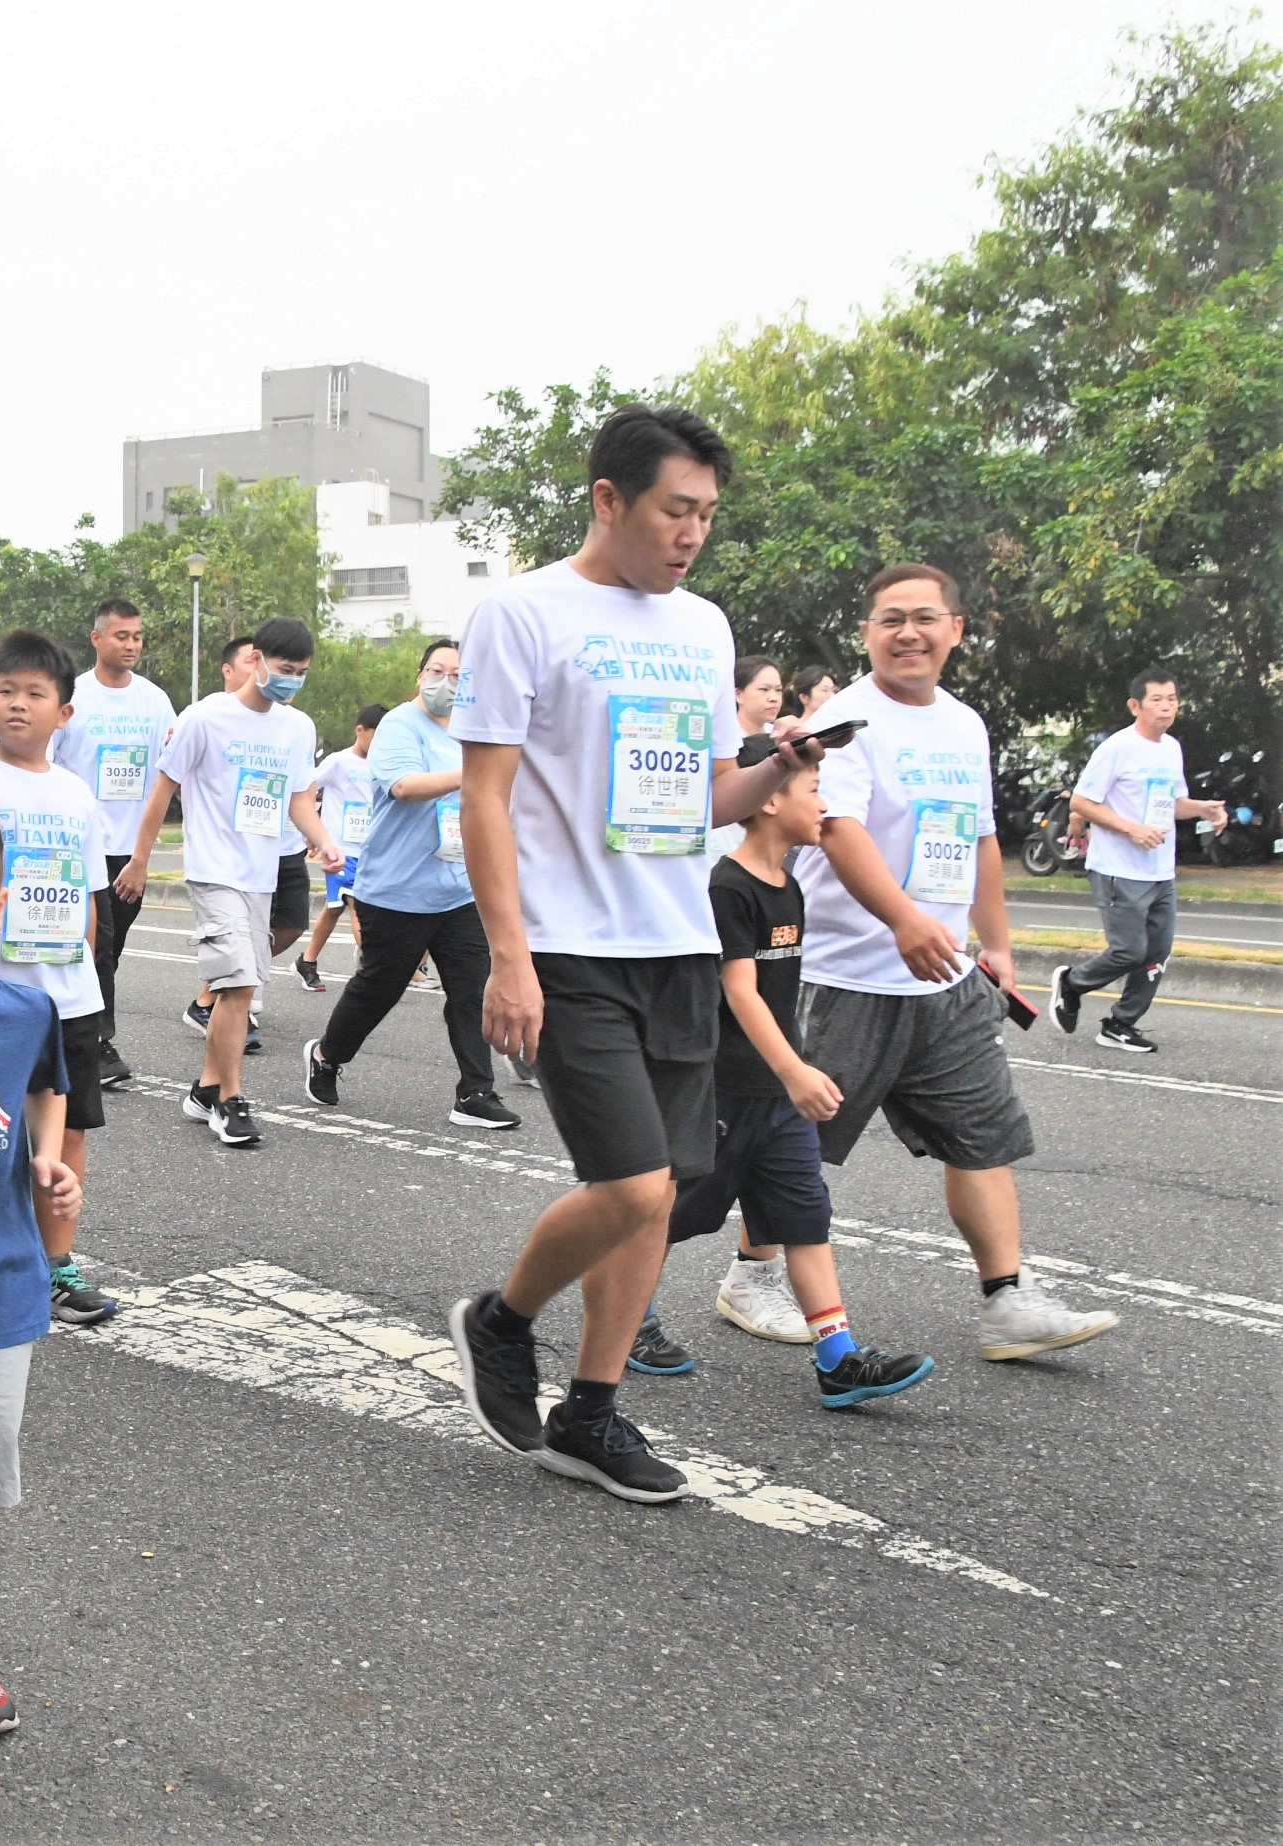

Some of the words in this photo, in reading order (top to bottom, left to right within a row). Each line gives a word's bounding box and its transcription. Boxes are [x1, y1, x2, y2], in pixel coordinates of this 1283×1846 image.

[621, 641, 678, 657] LIONS
[625, 660, 718, 685] TAIWAN
[248, 756, 288, 769] TAIWA
[629, 749, 700, 773] 30025
[106, 767, 141, 778] 30355
[243, 794, 278, 810] 30003
[21, 812, 64, 826] LIONS
[349, 817, 371, 826] 3010
[21, 829, 81, 849] TAIWA
[924, 842, 971, 861] 30027
[20, 886, 80, 904] 30026
